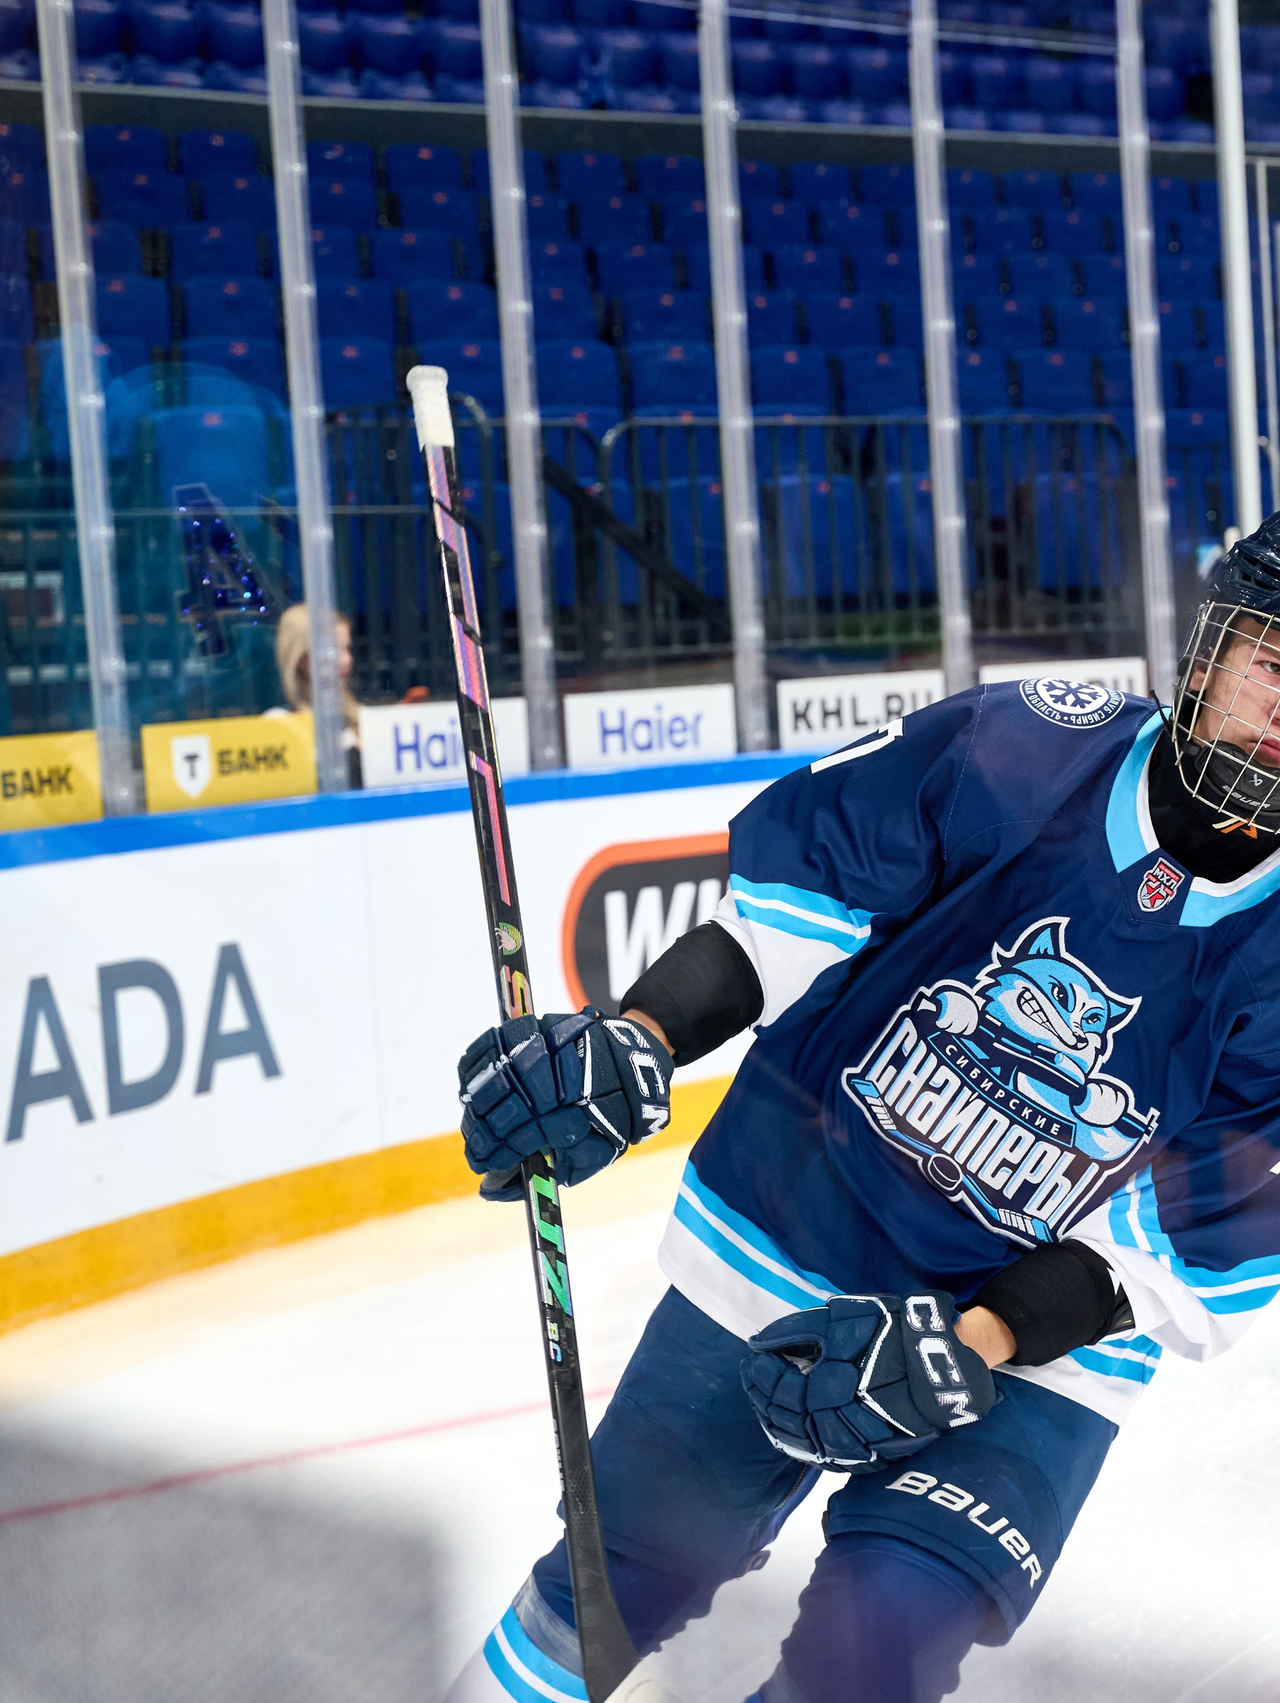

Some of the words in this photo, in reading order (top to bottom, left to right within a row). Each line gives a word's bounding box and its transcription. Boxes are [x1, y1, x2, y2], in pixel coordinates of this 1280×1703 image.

[1028, 694, 1061, 720] ОБЛАСТЬ
[1070, 711, 1106, 725] СИБИРЬ
[393, 714, 468, 772] Hai
[597, 705, 704, 756] Haier
[1, 762, 76, 800] БАНК
[217, 743, 290, 777] БАНК
[1153, 867, 1178, 890] МХЛ
[4, 940, 284, 1146] ADA
[945, 1043, 1060, 1136] СИБИРСКИЕ
[905, 1295, 980, 1428] CCM
